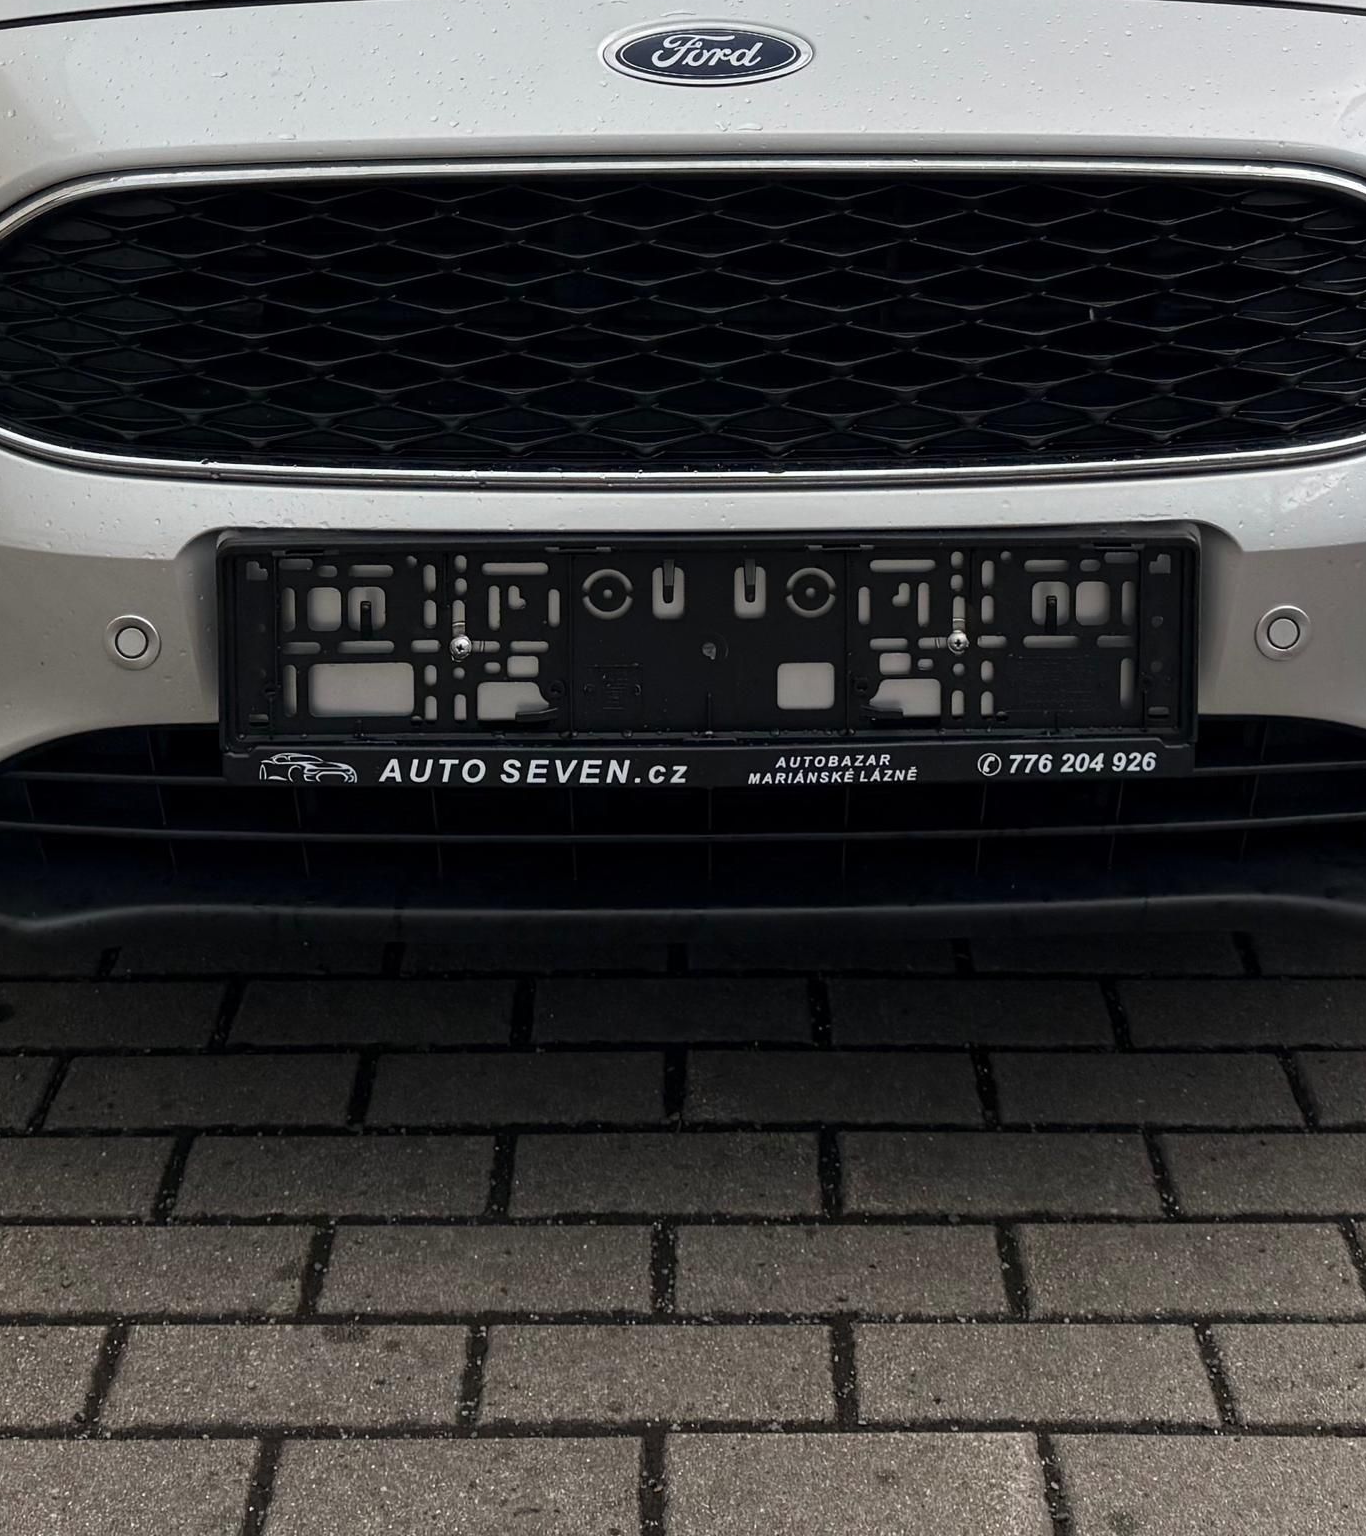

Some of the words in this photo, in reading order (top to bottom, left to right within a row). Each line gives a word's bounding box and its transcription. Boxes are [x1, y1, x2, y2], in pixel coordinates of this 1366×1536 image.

[651, 34, 763, 68] Ford
[379, 758, 487, 783] AUTO
[500, 759, 689, 784] SEVEN.cz
[775, 754, 891, 769] AUTOBAZAR
[1009, 753, 1054, 774] 776
[1060, 752, 1105, 773] 204
[1111, 750, 1157, 772] 926
[748, 768, 854, 785] MARIÁNSKÉ
[859, 766, 918, 783] LÁZNĚ
